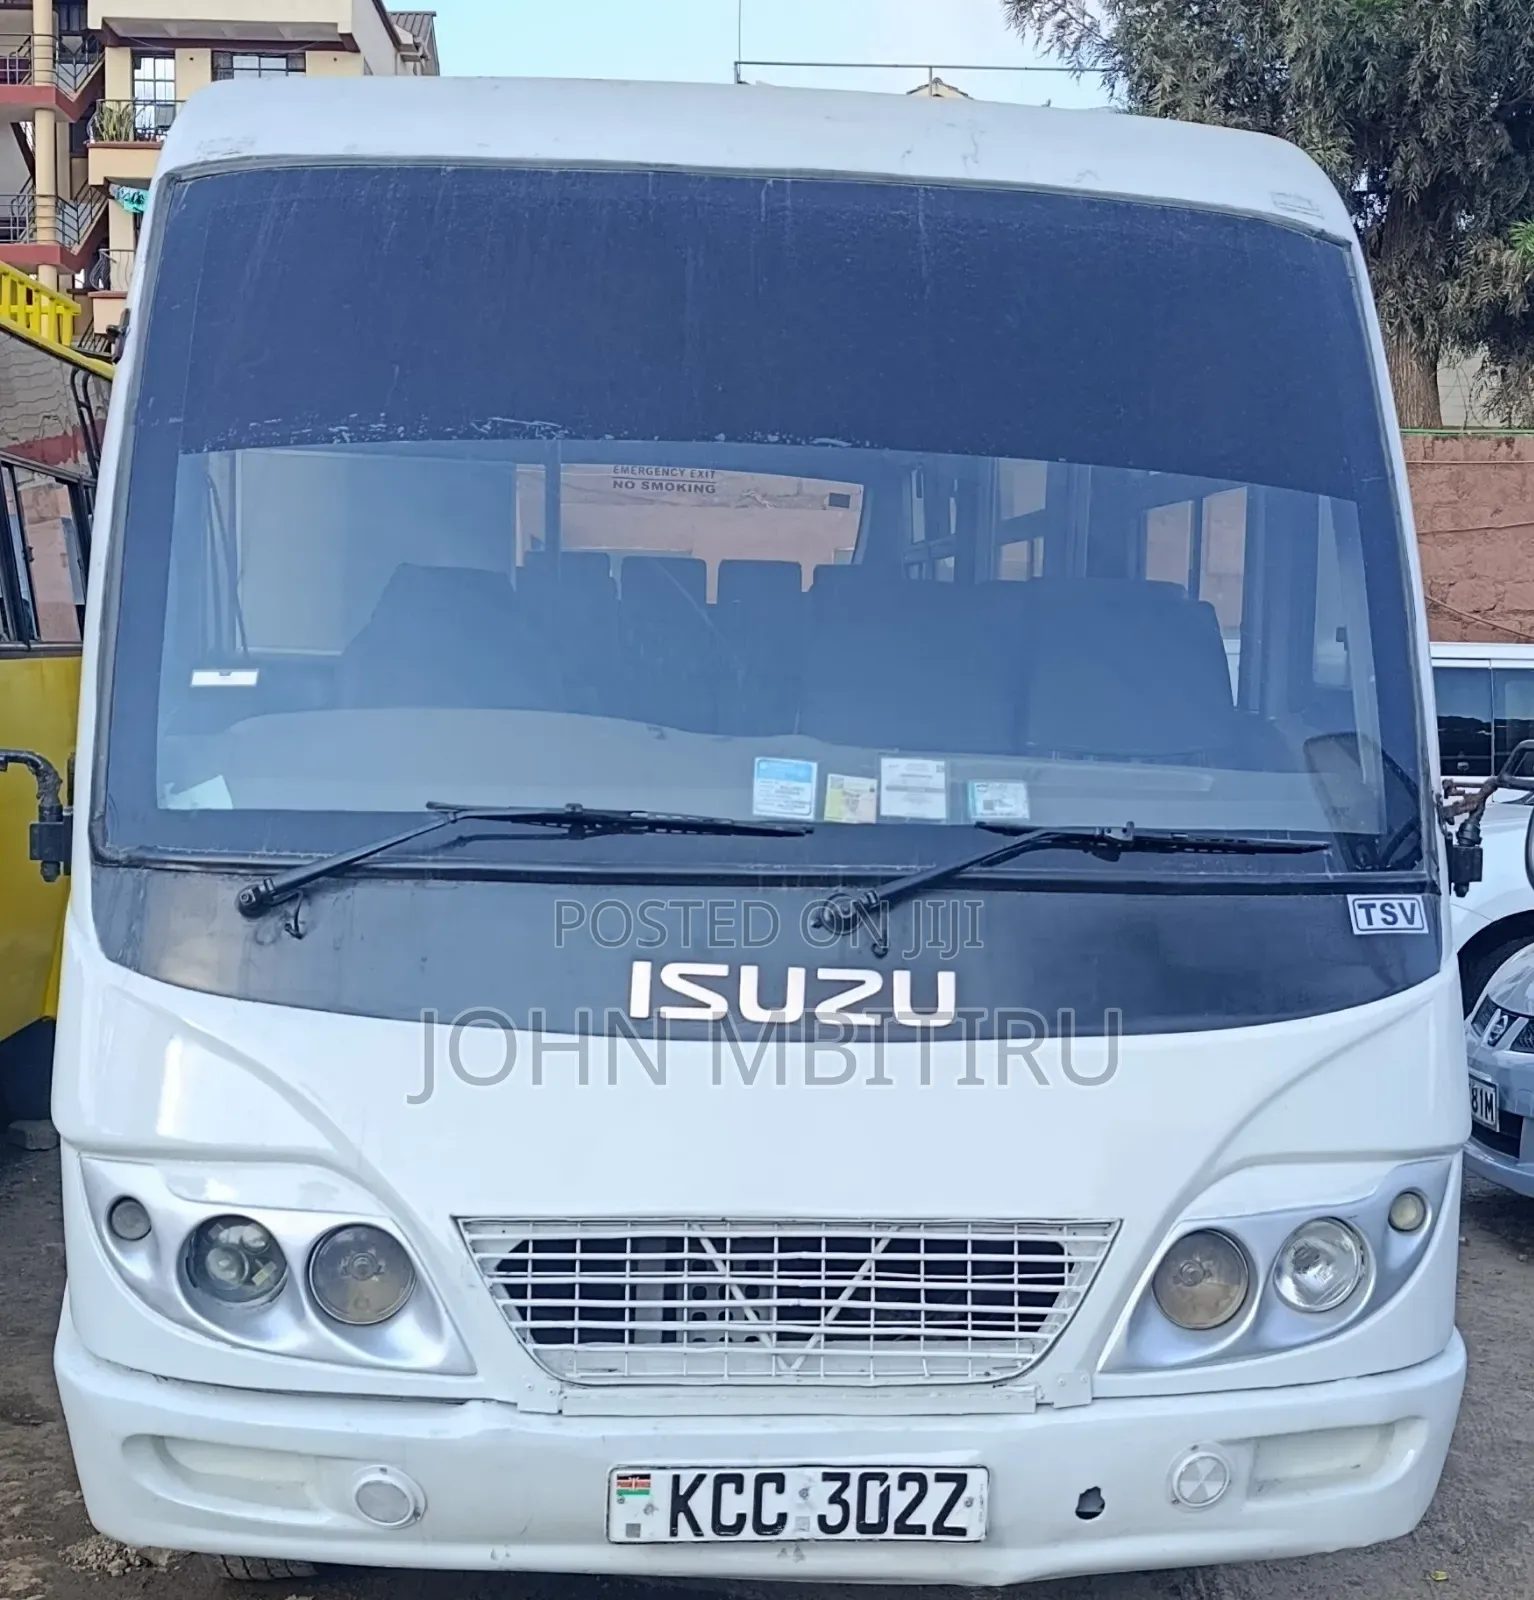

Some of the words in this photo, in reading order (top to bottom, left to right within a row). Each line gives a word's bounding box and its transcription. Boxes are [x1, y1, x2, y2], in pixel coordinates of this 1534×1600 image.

[612, 465, 686, 477] EMERGENCY
[690, 469, 716, 480] EXIT
[612, 480, 636, 490] NO
[641, 481, 716, 494] SMOKING
[1357, 902, 1417, 927] TSV
[629, 960, 956, 1028] ISUZU
[669, 1472, 789, 1537] KCC
[817, 1471, 968, 1536] 302Z
